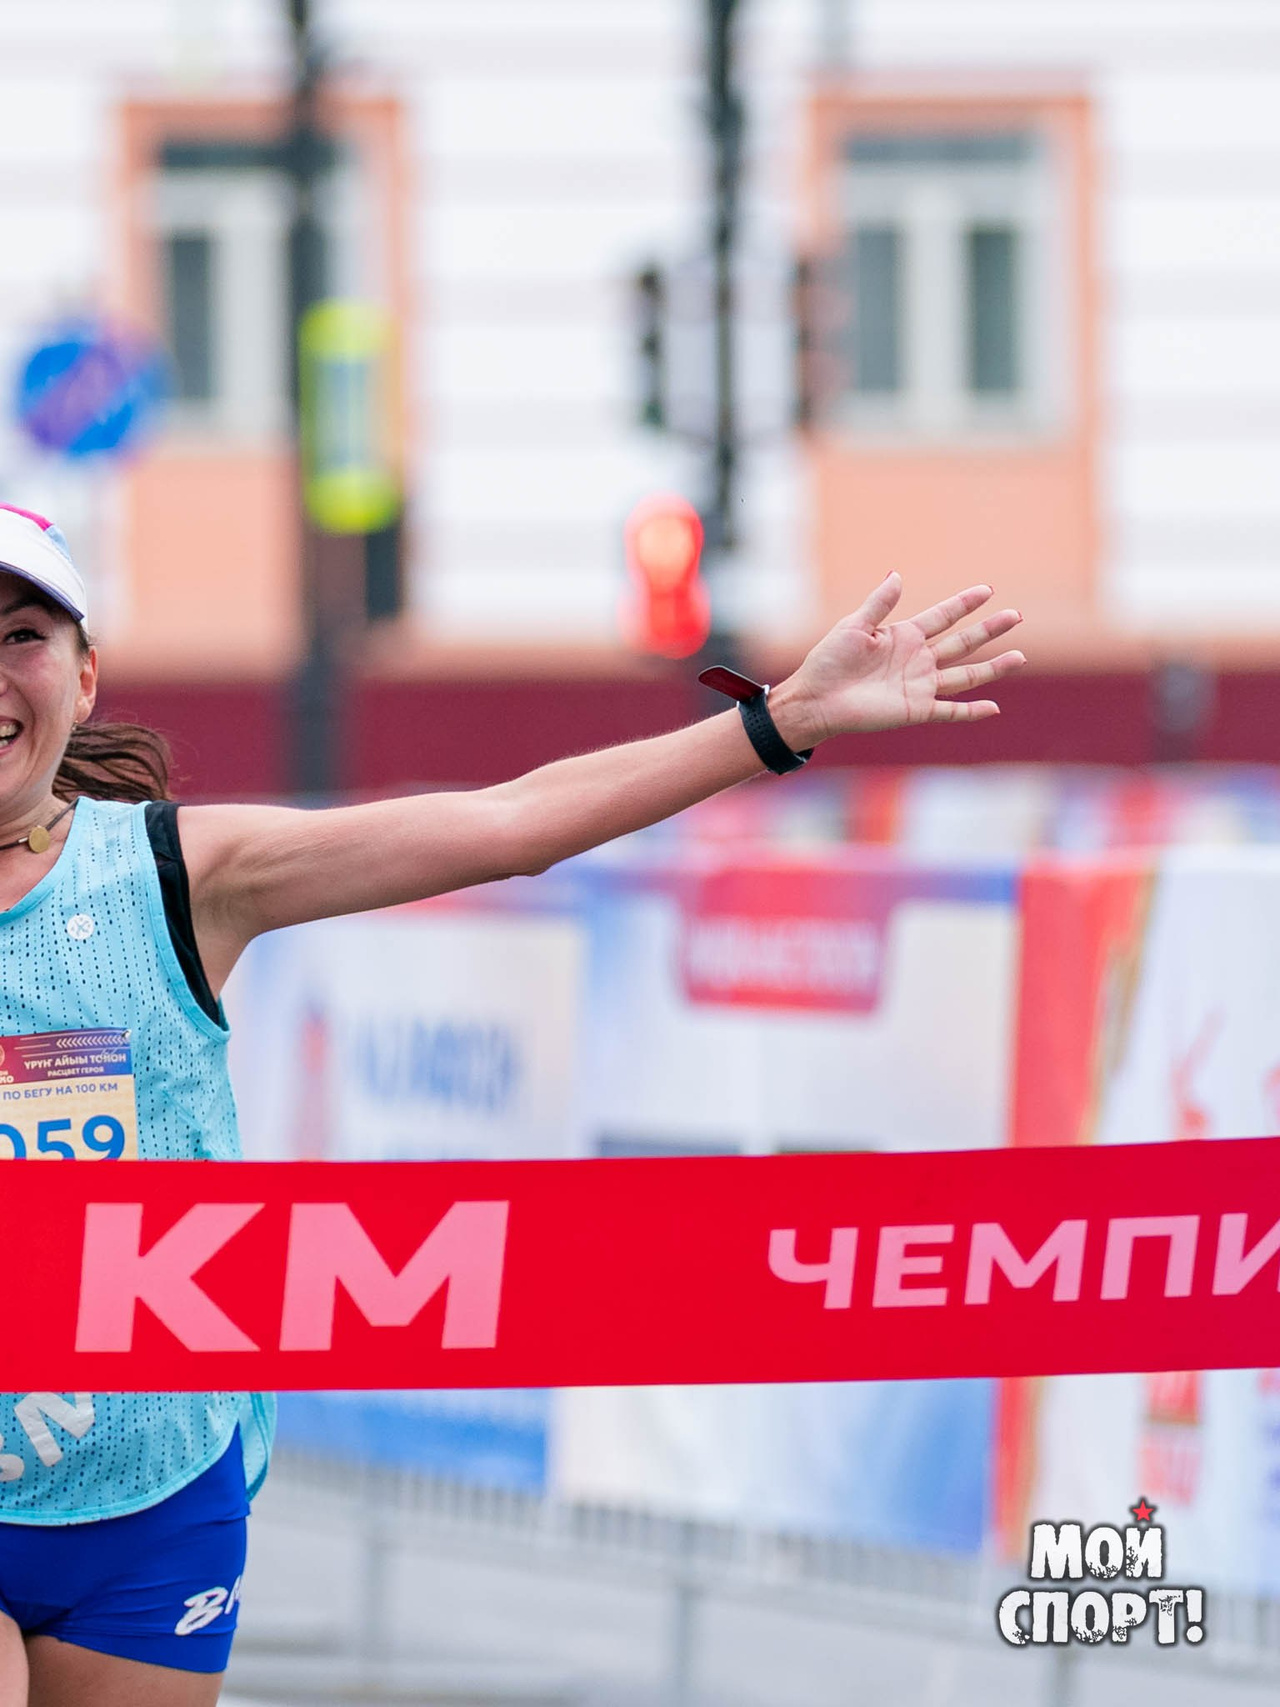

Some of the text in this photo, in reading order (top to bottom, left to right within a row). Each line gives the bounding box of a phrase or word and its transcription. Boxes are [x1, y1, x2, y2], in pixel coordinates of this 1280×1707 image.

[3, 1090, 21, 1101] ПО
[24, 1087, 52, 1099] БЕГУ
[55, 1085, 73, 1096] НА
[75, 1083, 96, 1094] 100
[99, 1082, 119, 1092] КМ
[47, 1066, 104, 1077] РАСЦВЕТ ГЕРОЯ
[74, 1200, 511, 1353] КМ
[767, 1213, 1280, 1310] ЧЕМПИ
